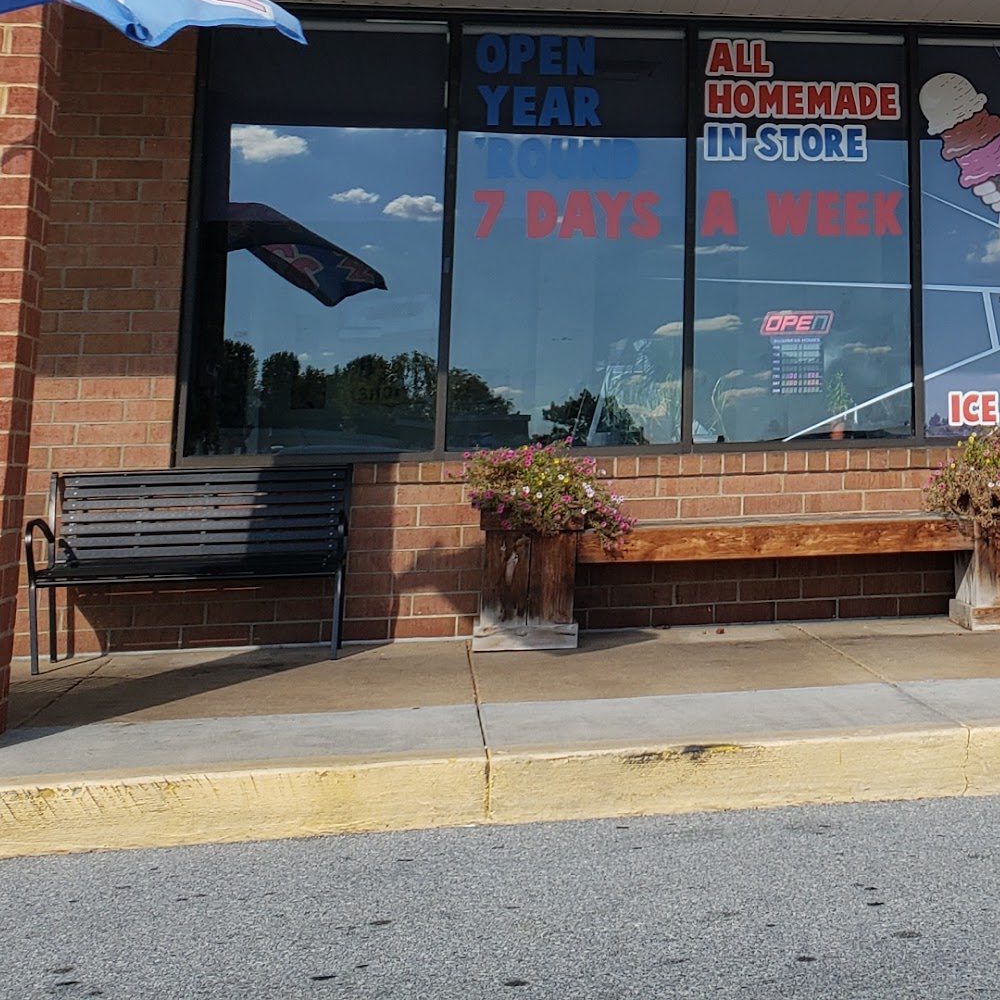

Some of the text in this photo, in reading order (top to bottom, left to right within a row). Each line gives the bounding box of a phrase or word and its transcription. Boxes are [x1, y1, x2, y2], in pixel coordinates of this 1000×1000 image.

[474, 32, 597, 76] OPEN
[706, 39, 773, 76] ALL
[478, 85, 602, 128] YEAR
[706, 81, 900, 119] HOMEMADE
[705, 124, 867, 161] IN STORE
[473, 190, 904, 240] 7 DAYS A WEEK
[765, 315, 828, 332] OPEN
[950, 392, 998, 425] ICE
